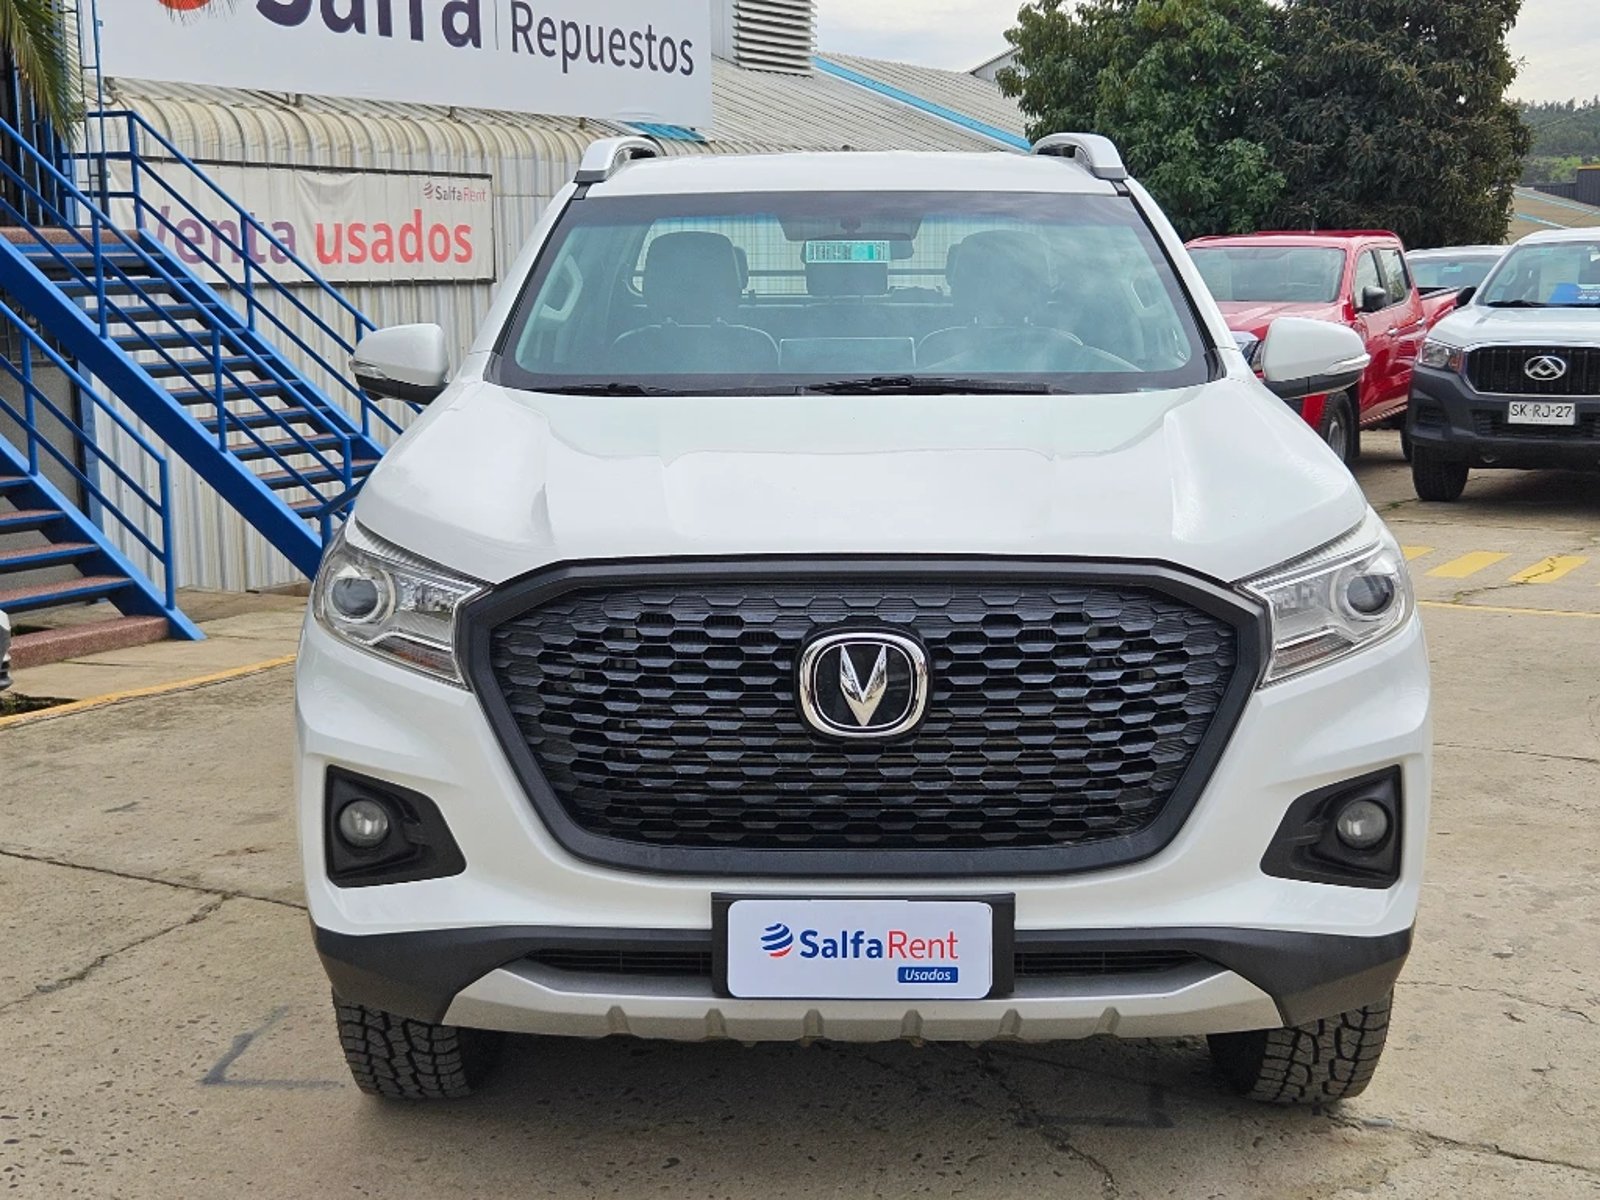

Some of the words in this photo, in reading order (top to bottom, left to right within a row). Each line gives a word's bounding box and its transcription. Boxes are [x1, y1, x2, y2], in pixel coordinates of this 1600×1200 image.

[511, 1, 694, 76] Repuestos
[435, 185, 486, 203] SalfaRent
[316, 208, 473, 264] usados
[799, 929, 959, 959] SalfaRent
[904, 968, 951, 981] Usados
